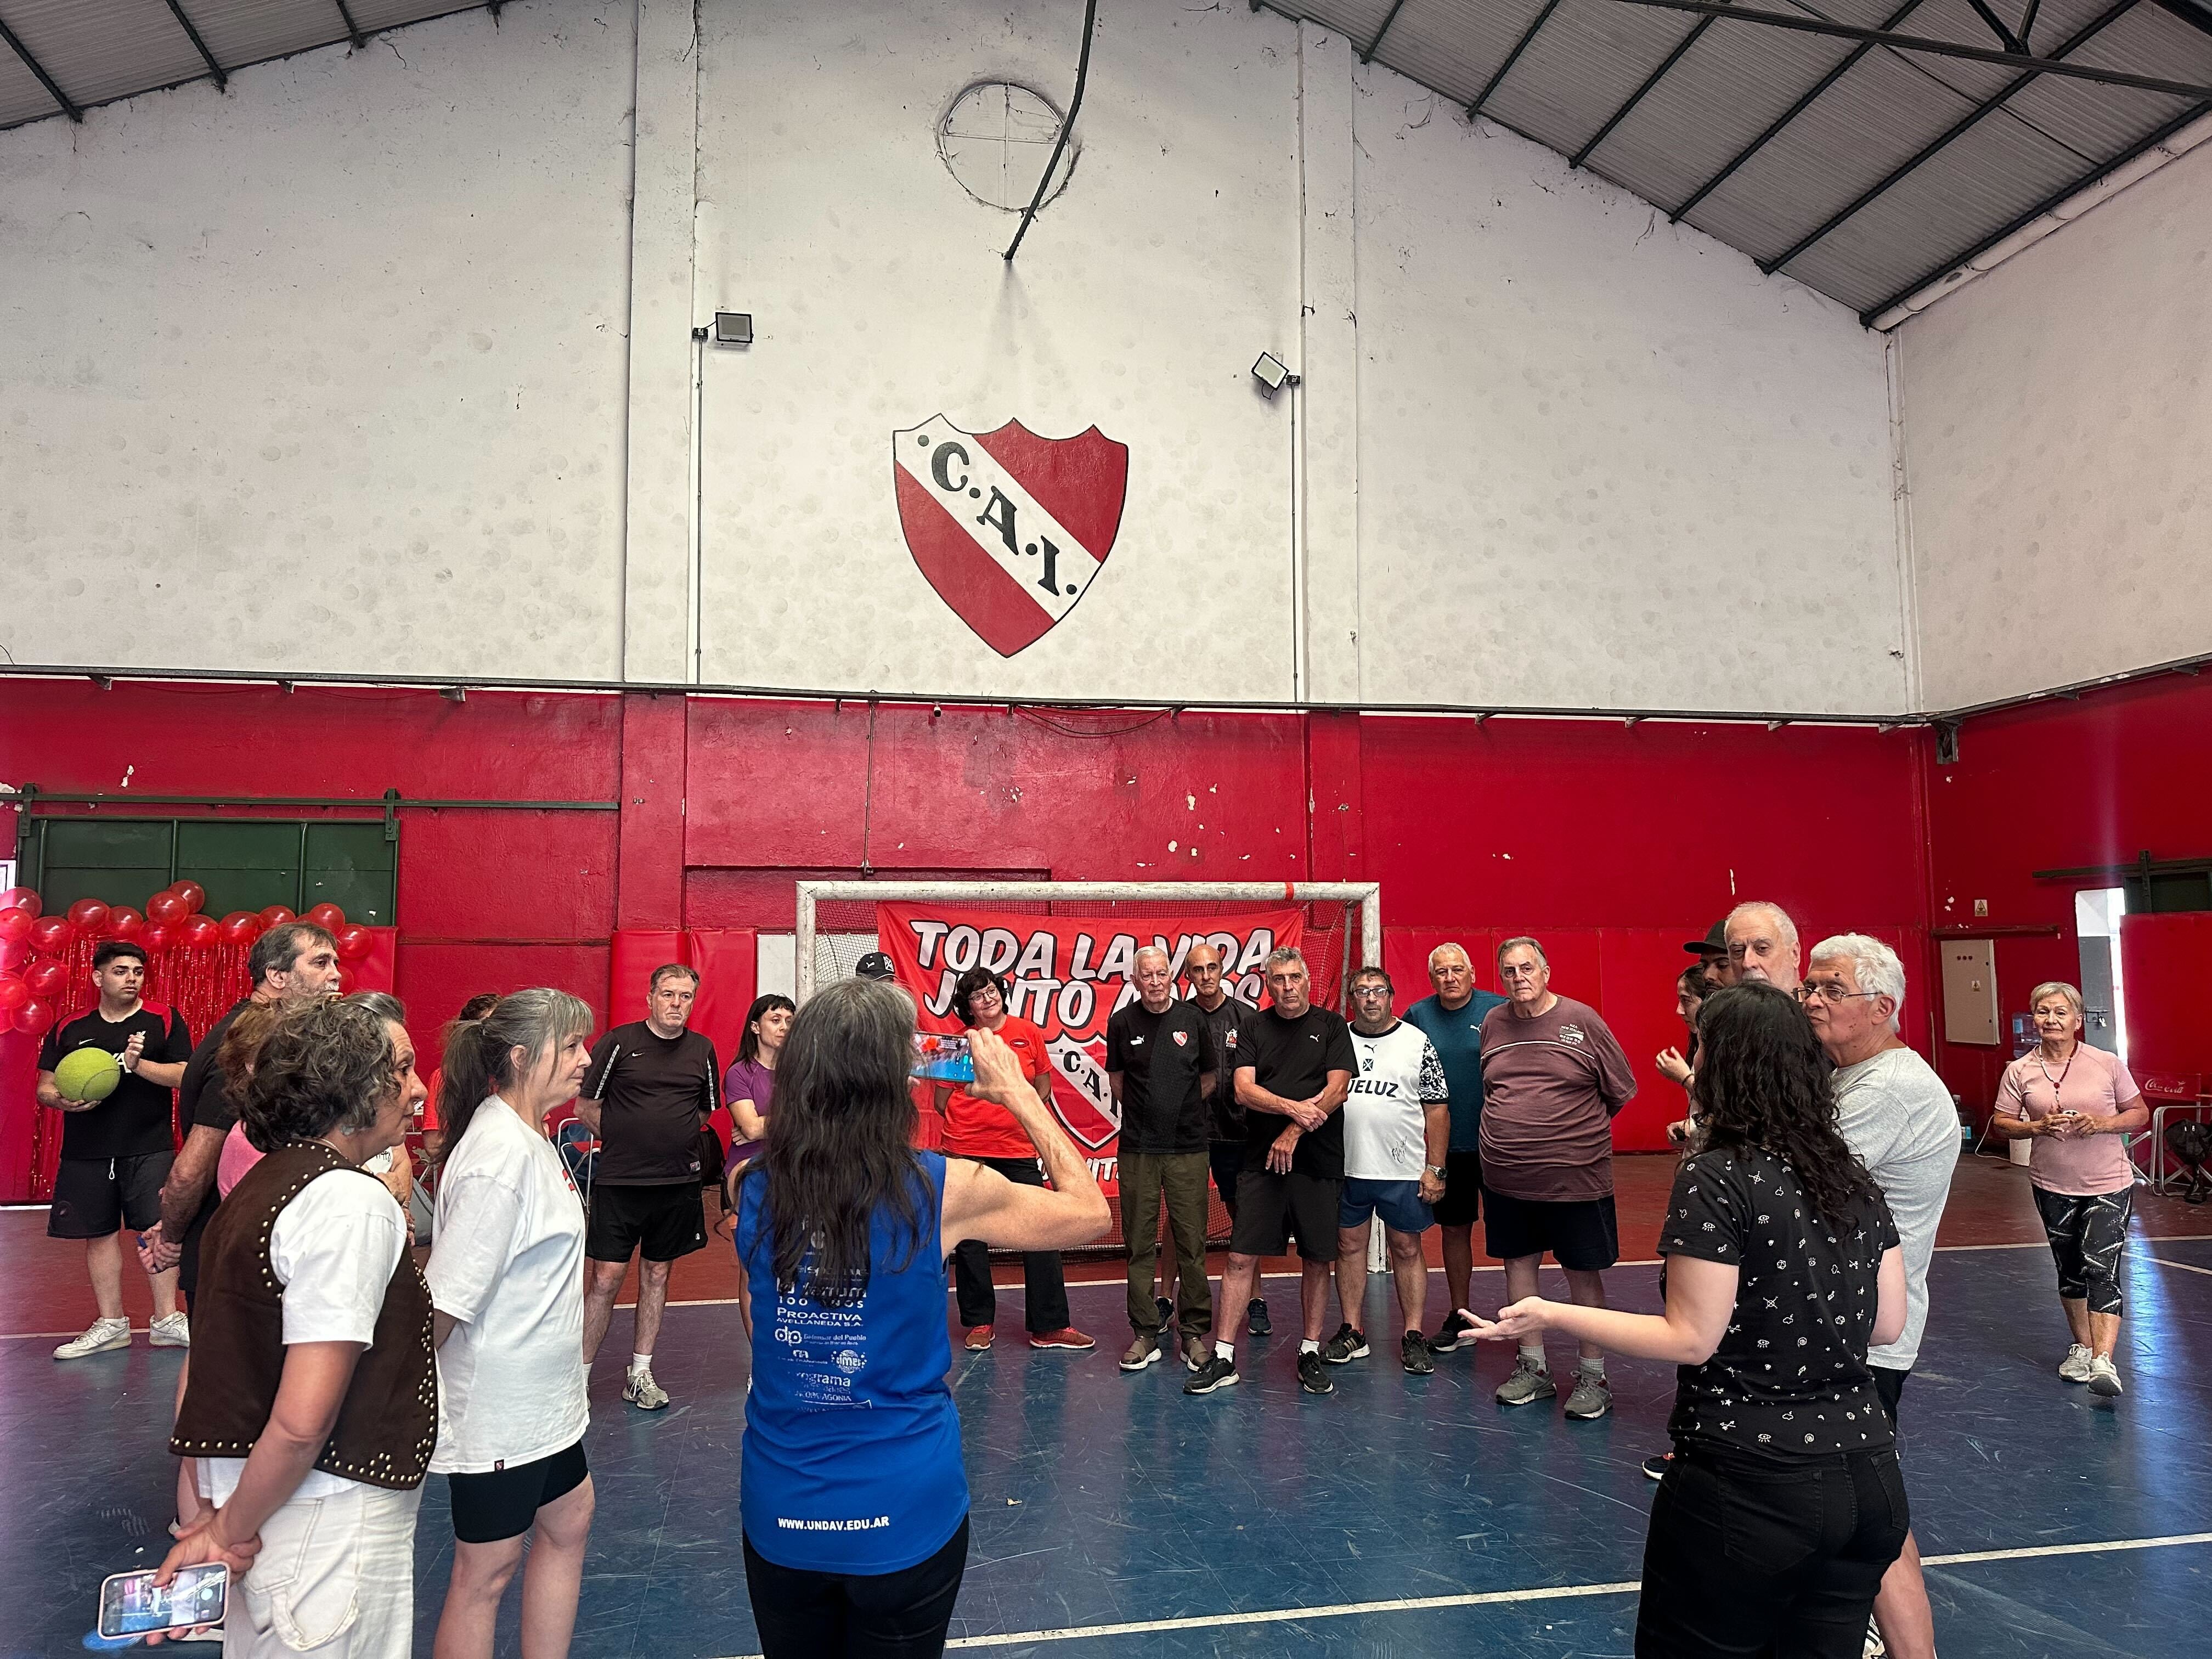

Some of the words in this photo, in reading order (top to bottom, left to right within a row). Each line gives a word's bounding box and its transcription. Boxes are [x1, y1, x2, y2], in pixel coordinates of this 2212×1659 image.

[909, 920, 1055, 979] TODA
[1071, 933, 1135, 981] LA
[1154, 929, 1273, 979] VDA
[777, 1307, 862, 1321] PROACTIVA
[776, 1317, 842, 1327] AVELLANEDA
[777, 1516, 890, 1531] WWW.UNDAV.EDU.AR
